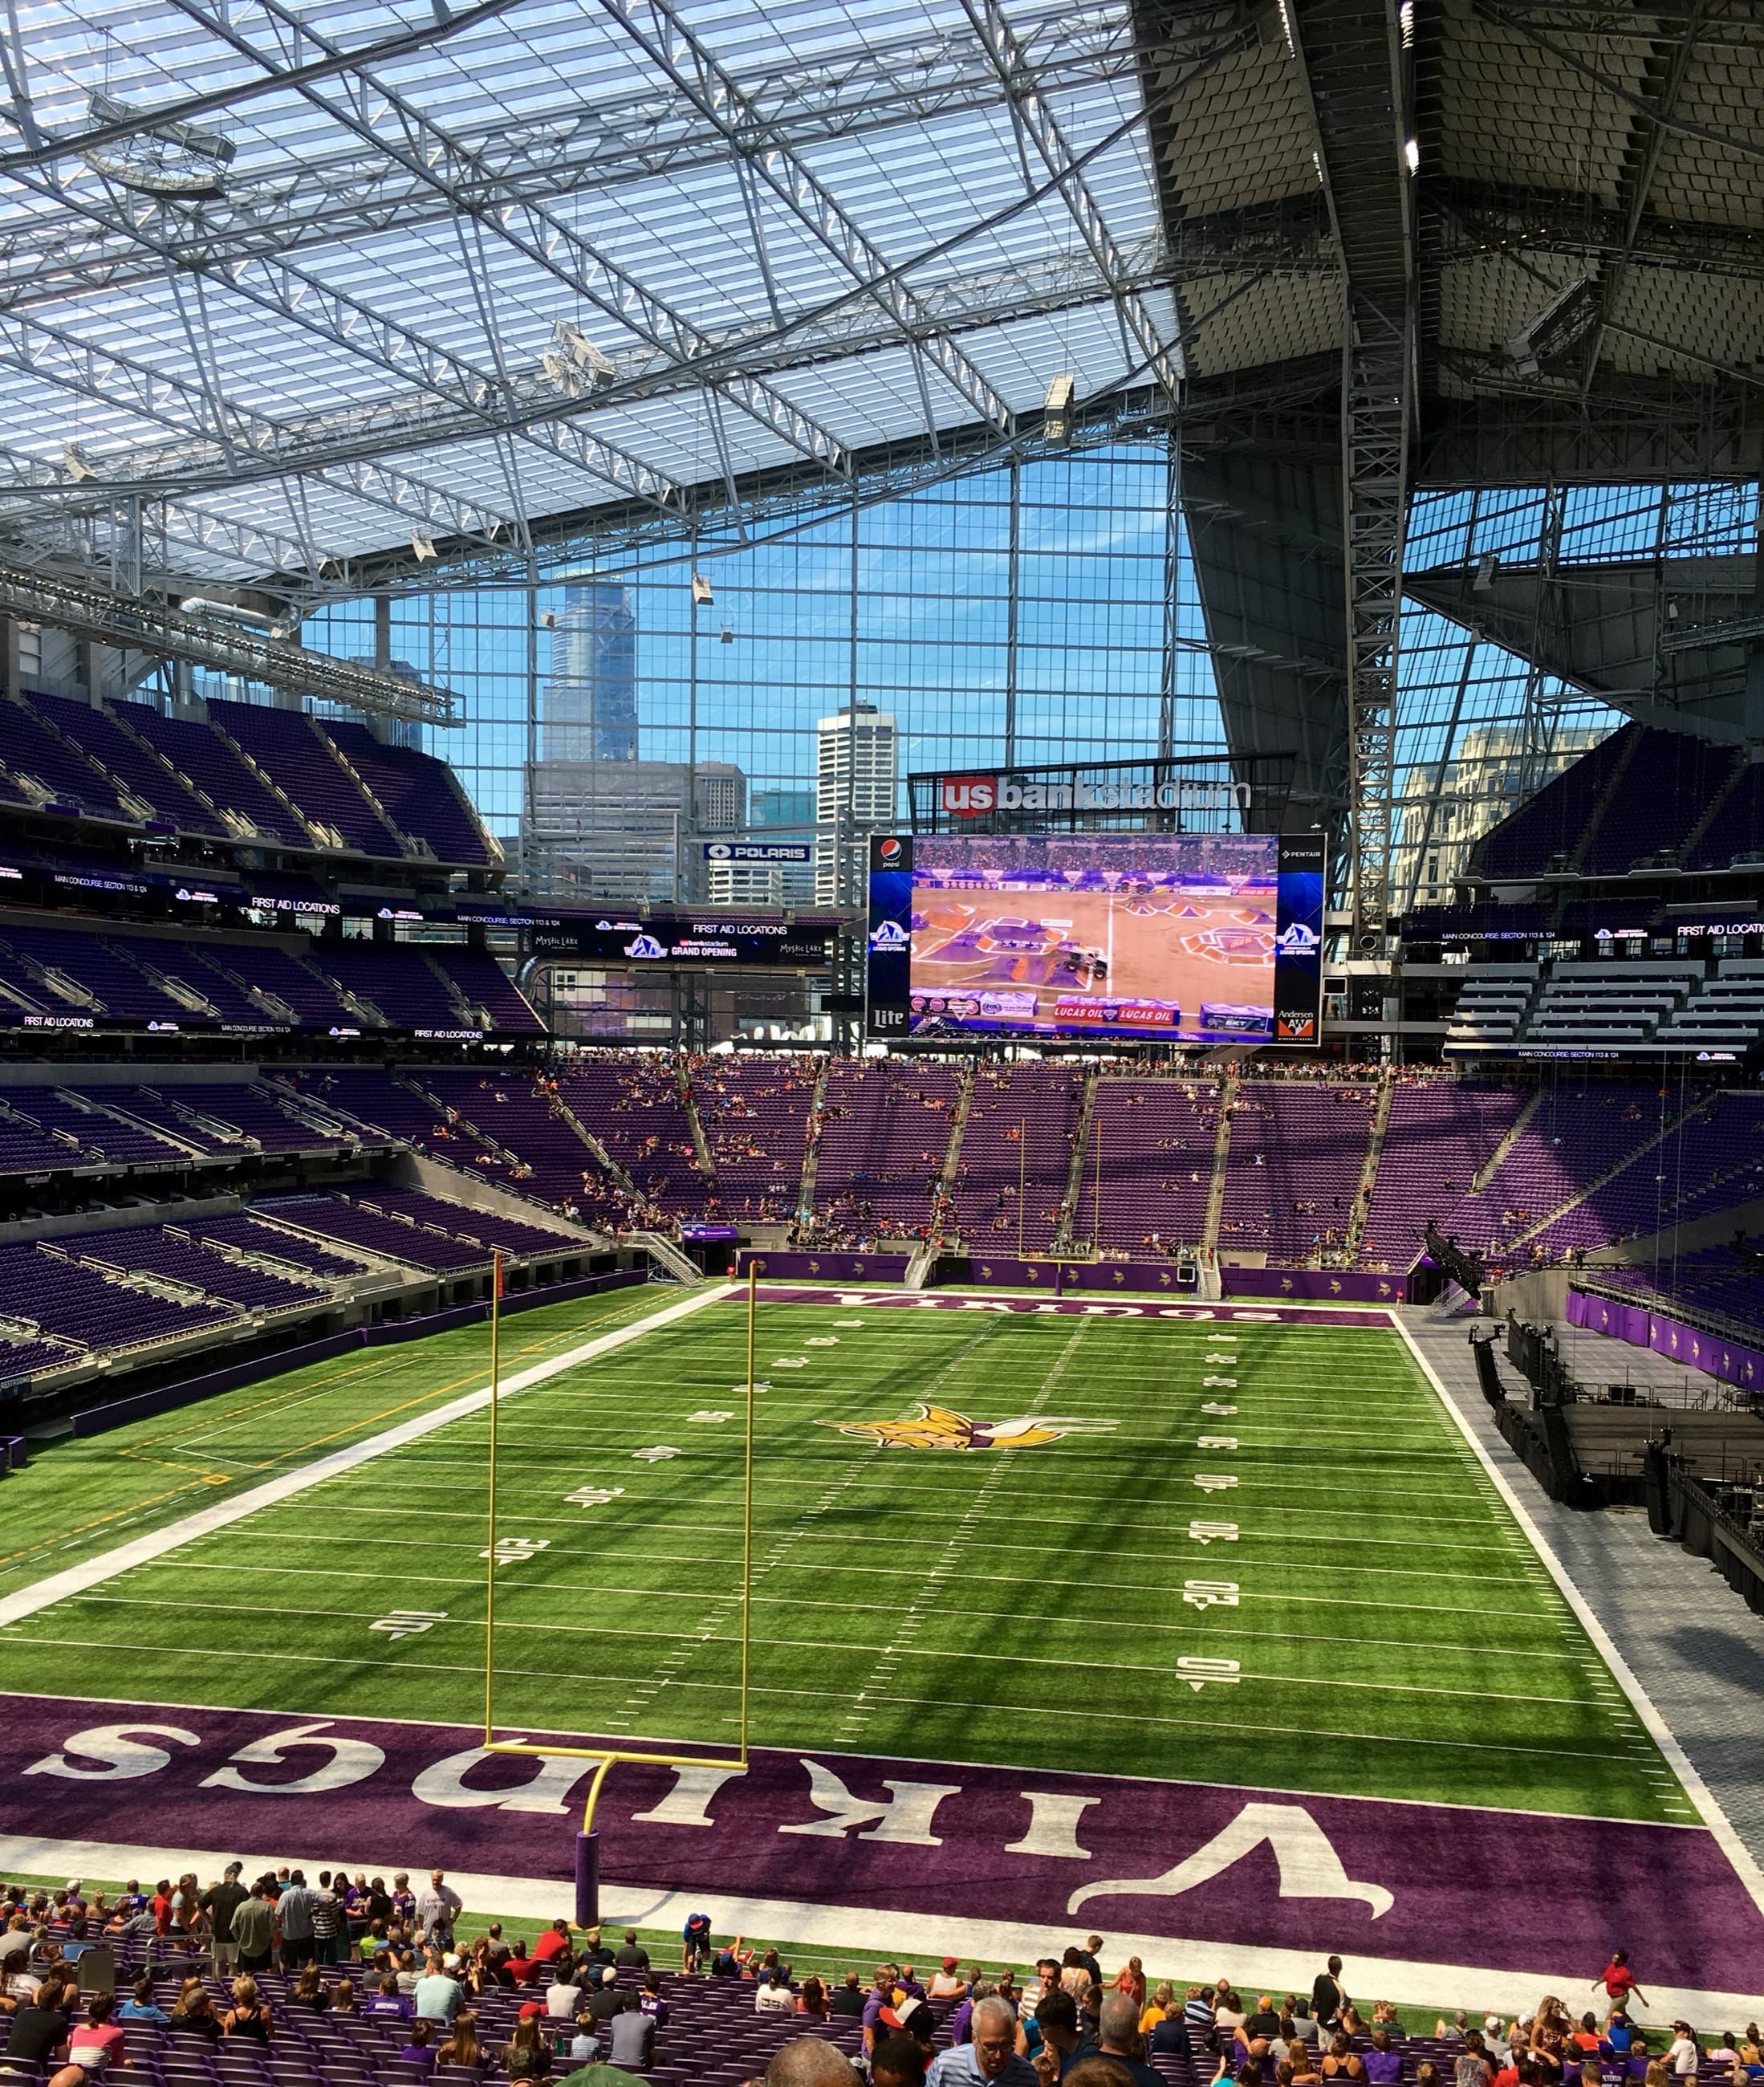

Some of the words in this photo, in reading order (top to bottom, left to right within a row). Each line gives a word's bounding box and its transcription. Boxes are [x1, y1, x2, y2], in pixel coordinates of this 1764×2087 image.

[735, 847, 806, 859] POLARIS
[55, 874, 69, 884] MAIN
[104, 881, 126, 891] SECTION
[252, 897, 277, 909] FIRST
[277, 900, 292, 910] AID
[293, 902, 340, 914] LOCATIONS
[457, 914, 472, 922] MAIN
[510, 917, 534, 926] SECTION
[693, 924, 717, 934] FIRST
[719, 925, 736, 934] AID
[737, 926, 788, 935] LOCATIONS
[1677, 926, 1705, 936] FIRST
[1706, 925, 1725, 935] AID
[535, 935, 560, 946] Mystic
[672, 946, 700, 956] GRAND
[701, 947, 738, 957] OPENING
[780, 943, 805, 954] Mystic
[1055, 1007, 1087, 1017] LUCAS
[1087, 1008, 1104, 1018] OIL
[1120, 1010, 1152, 1020] LUCAS
[1154, 1012, 1171, 1021] OIL
[1278, 1010, 1314, 1018] Andersen
[24, 1016, 43, 1026] FIRST
[43, 1017, 55, 1027] AID
[55, 1017, 94, 1027] LOCATIONS
[873, 1009, 904, 1029] Lite
[414, 1029, 434, 1038] FIRST
[434, 1030, 446, 1039] AID
[446, 1030, 483, 1039] LOCATIONS
[563, 1486, 625, 1504] 30
[1189, 1520, 1238, 1540] 30
[478, 1537, 551, 1560] 20
[1182, 1580, 1239, 1605] 20
[368, 1609, 449, 1633] 10
[1175, 1656, 1240, 1683] 10
